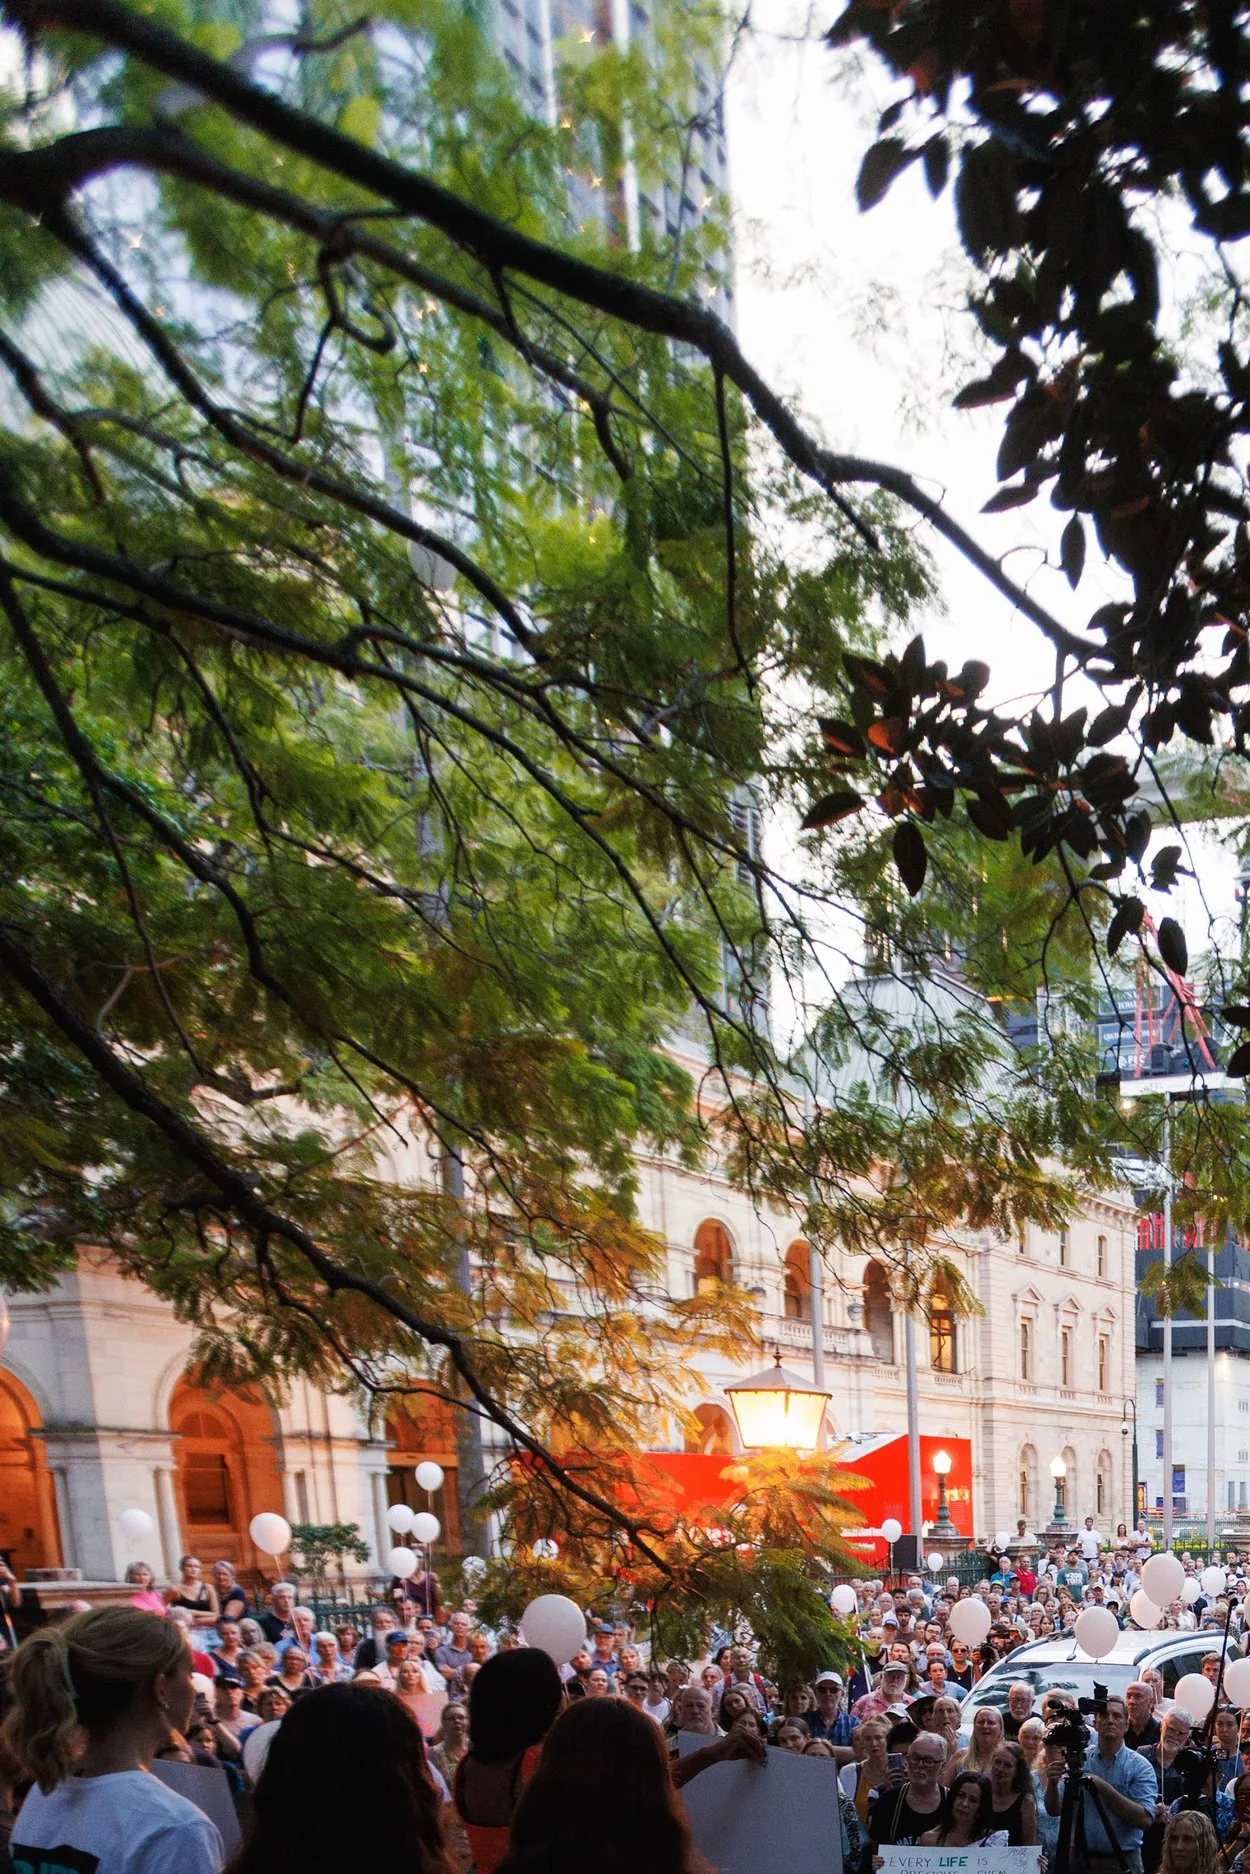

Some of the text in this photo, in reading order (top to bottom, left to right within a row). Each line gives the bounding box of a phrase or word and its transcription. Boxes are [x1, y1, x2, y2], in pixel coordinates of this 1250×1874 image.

[889, 1856, 988, 1868] EVERY LIFE IS
